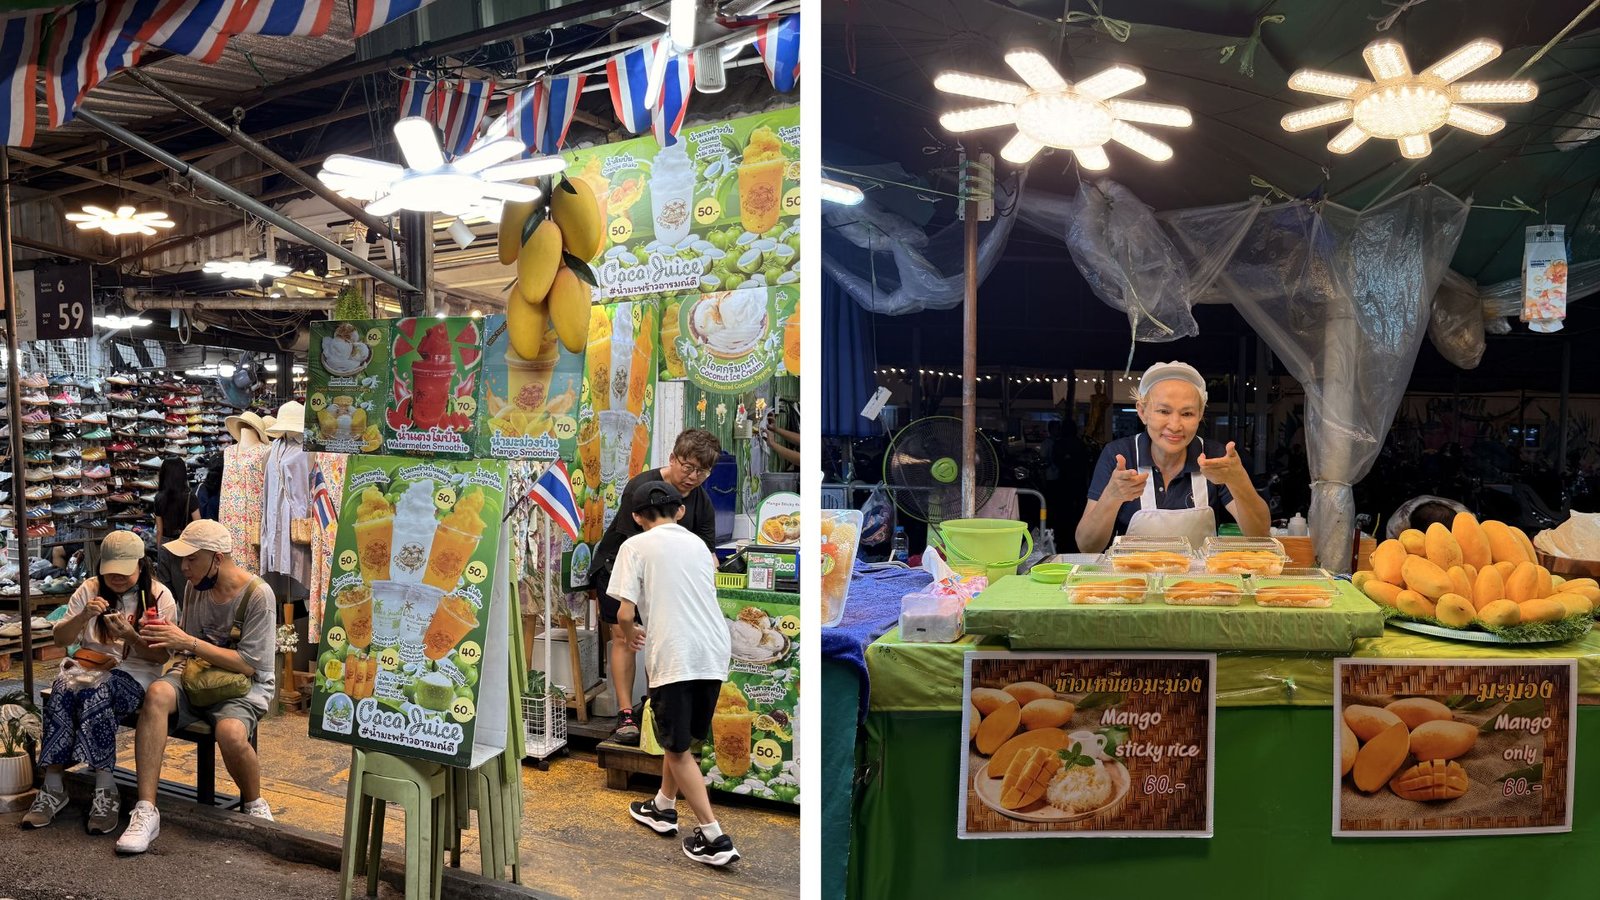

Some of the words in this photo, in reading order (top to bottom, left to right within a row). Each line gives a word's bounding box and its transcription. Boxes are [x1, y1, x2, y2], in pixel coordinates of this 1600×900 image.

[698, 205, 719, 217] 50.-
[612, 225, 631, 235] 50.-
[57, 280, 65, 293] 6
[58, 301, 84, 331] 59
[367, 332, 381, 342] 60.-
[706, 354, 758, 374] ไอศกรีมกะทิ
[700, 366, 729, 381] Coconut
[730, 373, 741, 381] Ice
[741, 362, 764, 378] Cream
[457, 401, 475, 411] 70.-
[397, 424, 461, 444] น้ำแตงโมปั่น
[556, 422, 576, 433] 70.-
[388, 440, 431, 450] Watermelon
[432, 443, 469, 452] Smoothie
[490, 430, 559, 449] น้ำมะม่วงปั่น
[492, 448, 519, 457] Mango
[519, 448, 558, 458] Smoothie
[437, 493, 454, 505] 50.-
[341, 556, 356, 565] 50.-
[468, 566, 485, 578] 50.-
[329, 633, 345, 642] 40.-
[461, 648, 480, 658] 40.-
[381, 656, 397, 666] 40.-
[1055, 671, 1202, 696] ข้าวเหนียวมะม่วง
[1477, 675, 1553, 703] มะม่วง
[453, 704, 473, 716] 60.-
[408, 707, 461, 741] Juice
[1100, 708, 1162, 731] Mango
[1494, 714, 1552, 735] Mango
[757, 746, 780, 759] 50.-
[1115, 742, 1163, 763] sticky
[1166, 742, 1200, 758] rice
[1503, 745, 1537, 765] only
[1143, 774, 1186, 795] 60.-
[1503, 777, 1542, 798] 60.-
